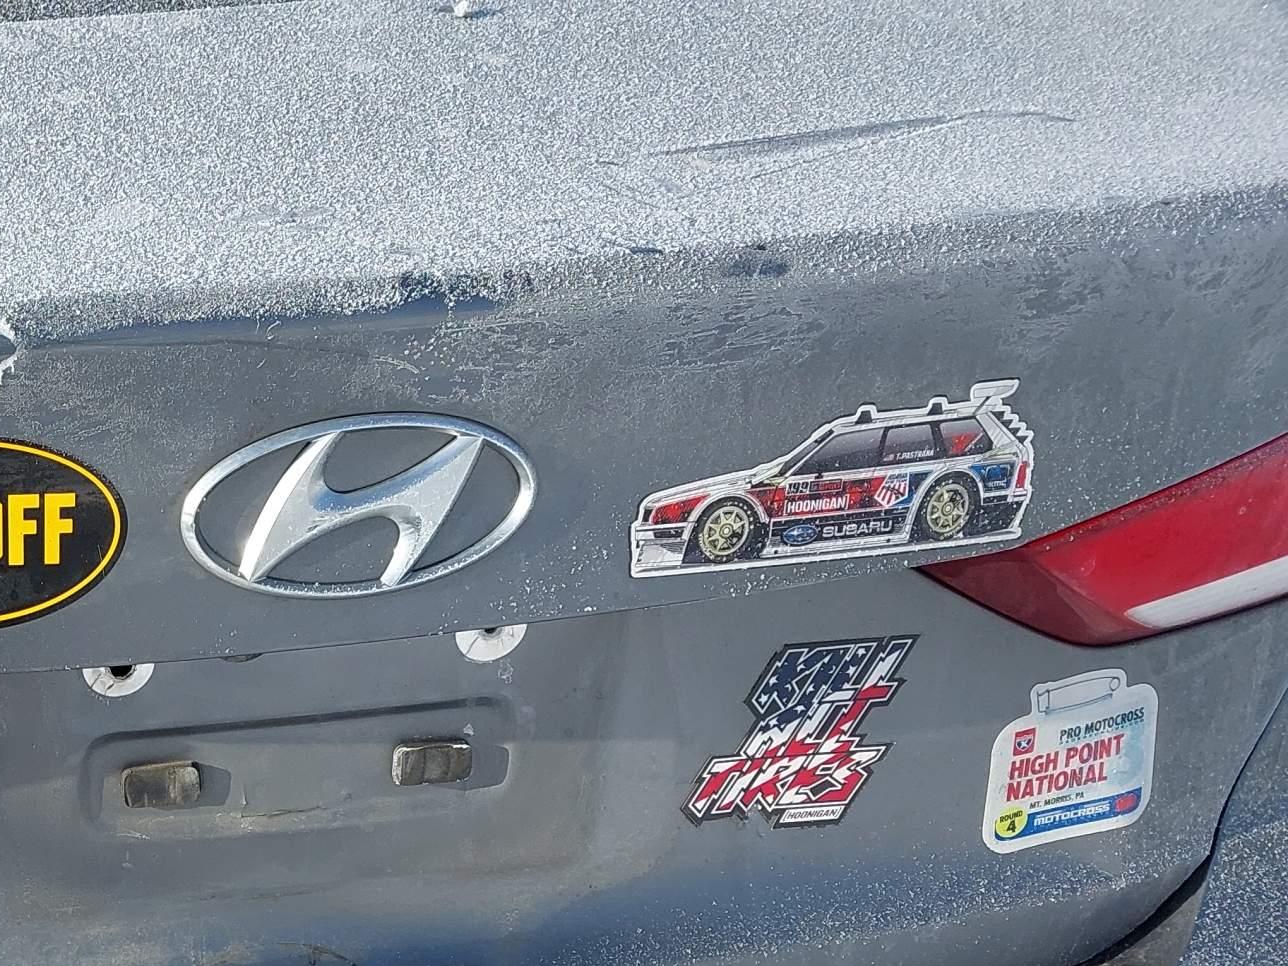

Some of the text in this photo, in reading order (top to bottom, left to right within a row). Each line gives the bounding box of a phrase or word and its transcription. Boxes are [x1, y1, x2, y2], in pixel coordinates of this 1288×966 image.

[822, 520, 892, 538] SUBARU
[1059, 726, 1082, 742] PRO
[1084, 707, 1144, 733] MOTOCROSS
[1009, 734, 1125, 780] HIGH POINT
[689, 745, 888, 819] TIRES
[1006, 762, 1107, 802] NATIONAL
[1075, 791, 1085, 799] PA
[999, 810, 1024, 823] ROUND
[1006, 820, 1017, 833] 4
